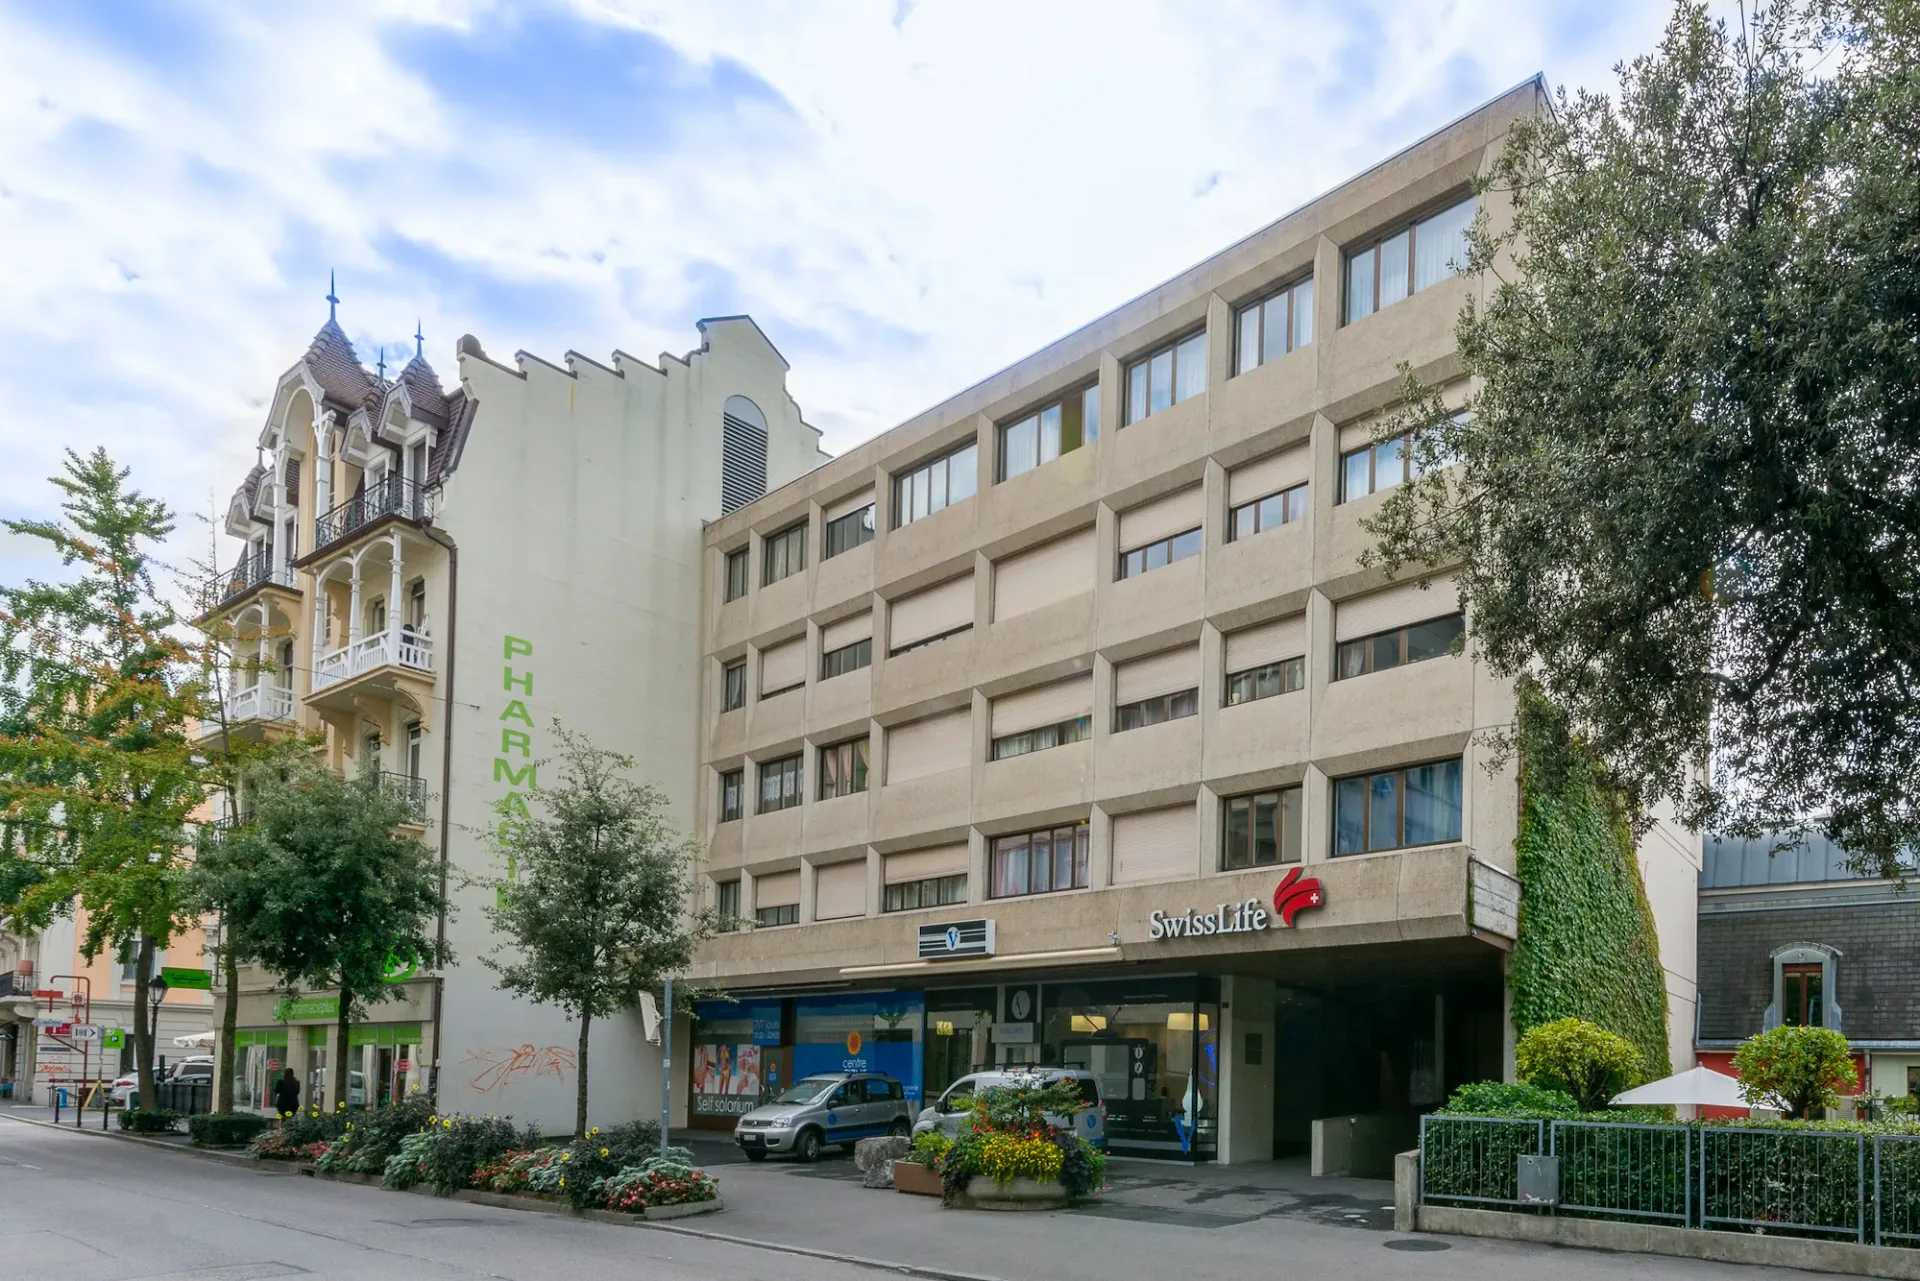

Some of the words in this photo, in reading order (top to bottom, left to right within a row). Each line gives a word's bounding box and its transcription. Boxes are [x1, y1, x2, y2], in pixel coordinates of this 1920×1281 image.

[1149, 897, 1267, 939] SwissLife
[842, 1057, 868, 1069] centre
[697, 1095, 714, 1112] Self
[714, 1096, 755, 1114] solarium
